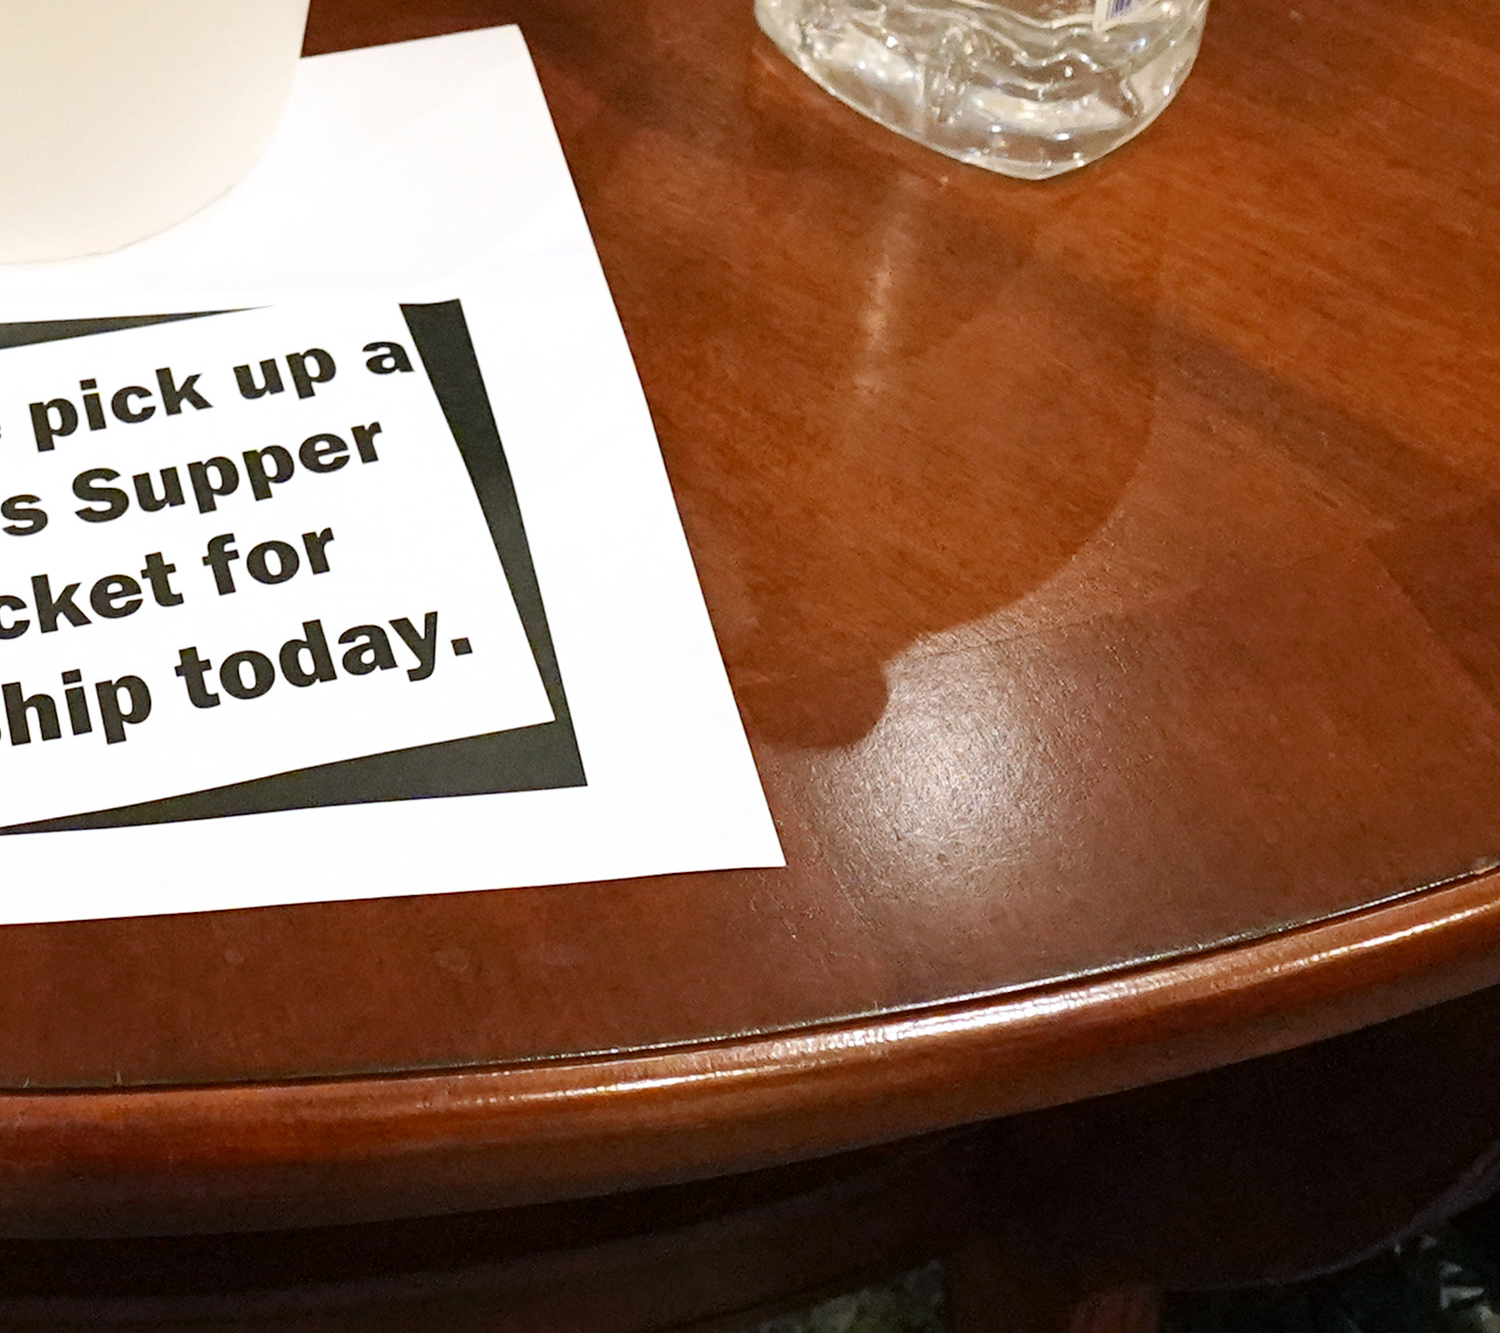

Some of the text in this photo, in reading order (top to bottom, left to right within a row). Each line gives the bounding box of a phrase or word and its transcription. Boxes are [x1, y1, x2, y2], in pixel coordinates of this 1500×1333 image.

[28, 367, 213, 453] pick
[232, 347, 337, 400] up
[363, 341, 415, 375] a
[71, 421, 383, 524] Supper
[201, 527, 335, 596] for
[174, 610, 473, 709] today.
